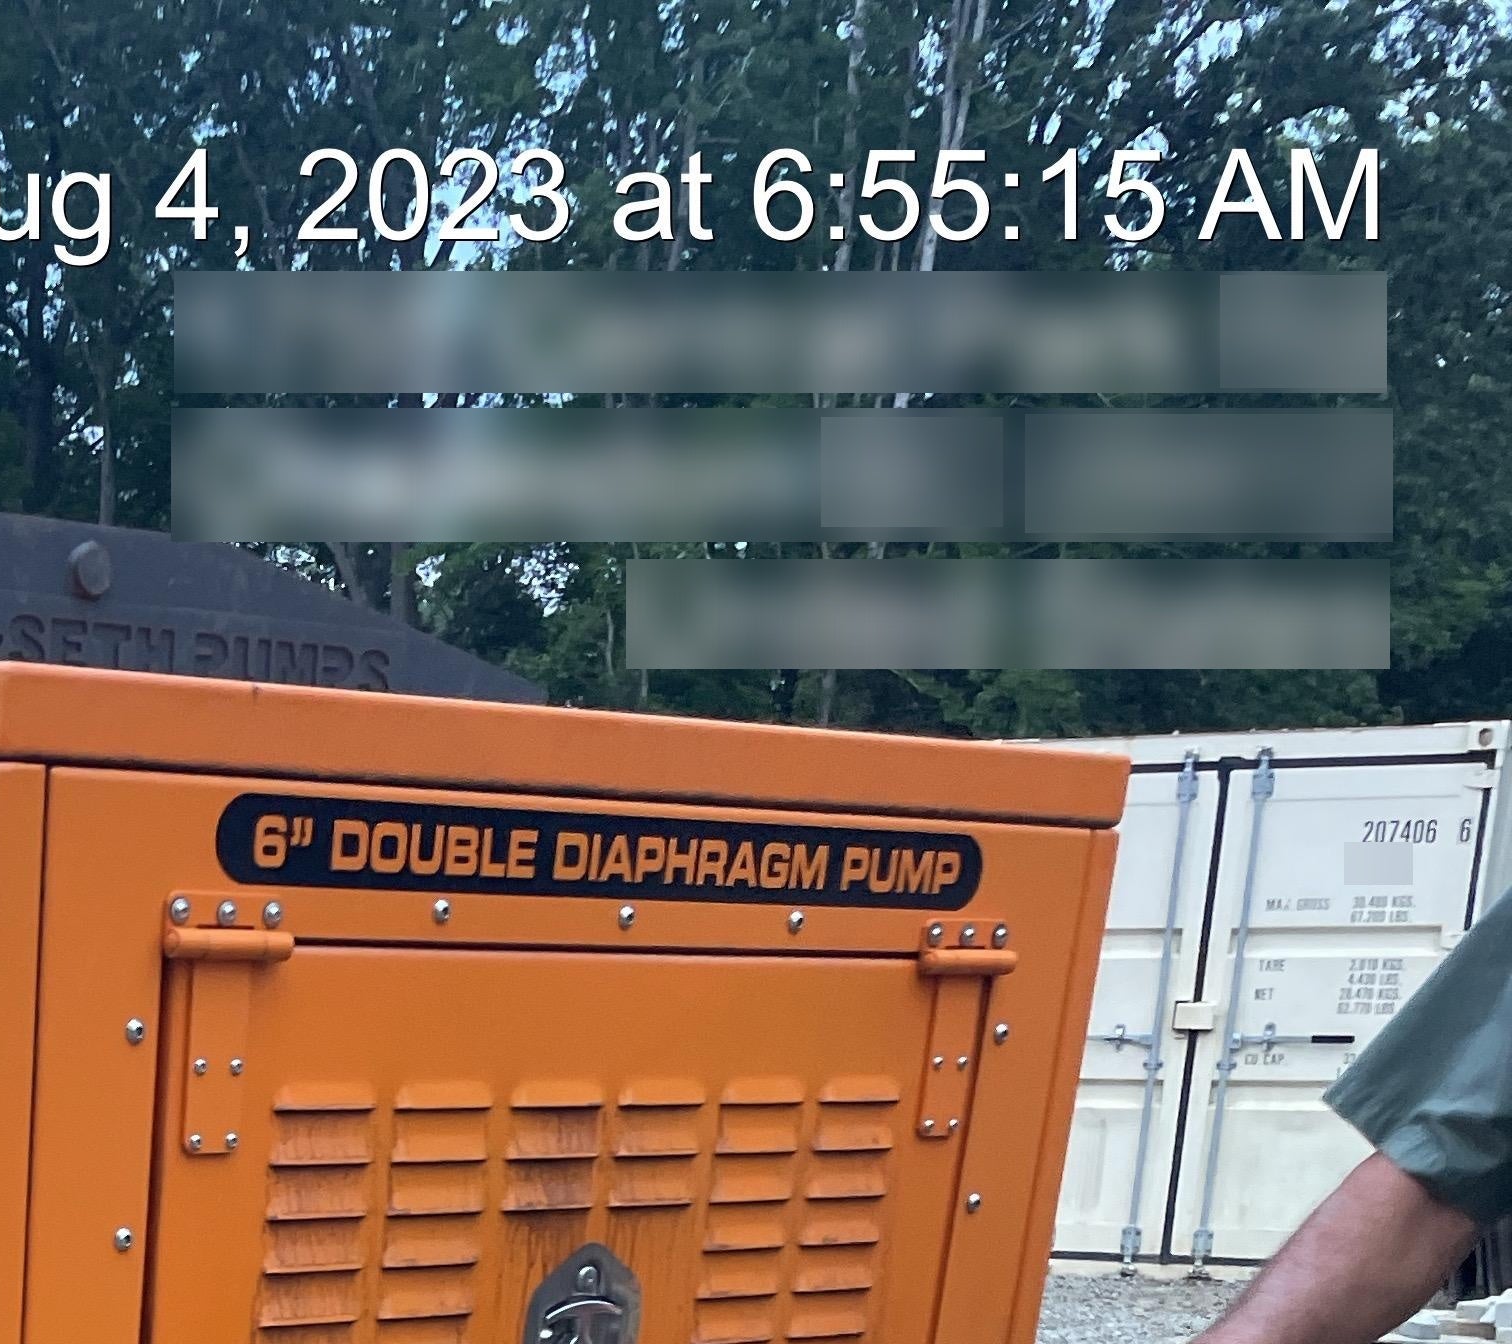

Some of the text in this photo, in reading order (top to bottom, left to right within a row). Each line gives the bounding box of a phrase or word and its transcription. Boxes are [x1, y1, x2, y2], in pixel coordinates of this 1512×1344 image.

[194, 631, 391, 691] PUMPS
[330, 818, 538, 878] DOUBLE
[553, 831, 829, 889] DIAPHRAGM
[841, 846, 961, 893] PUMP
[1361, 817, 1473, 845] 207406 6
